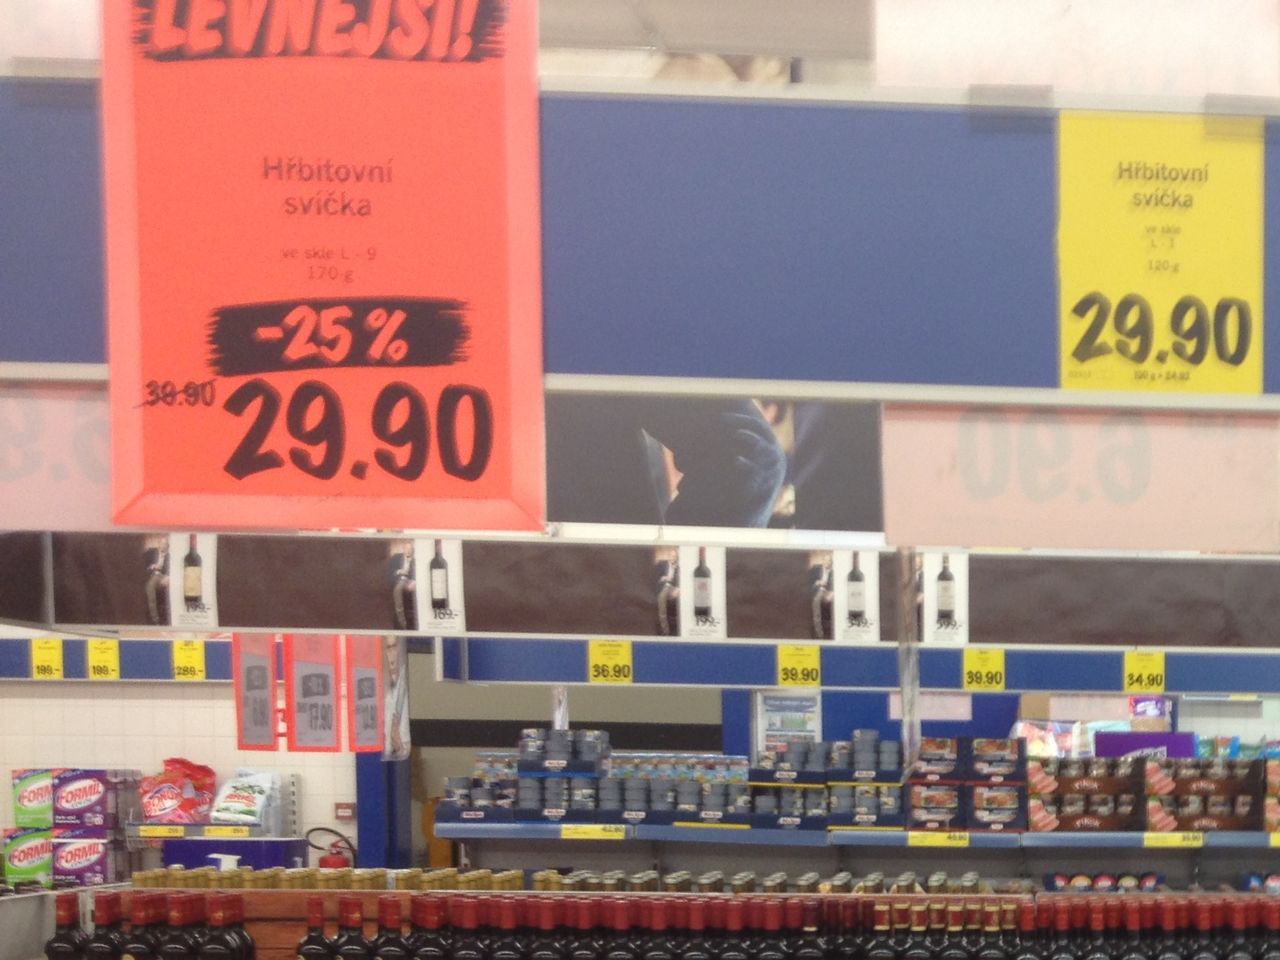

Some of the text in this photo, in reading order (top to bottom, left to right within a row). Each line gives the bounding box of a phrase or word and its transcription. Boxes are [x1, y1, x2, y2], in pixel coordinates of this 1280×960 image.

[262, 156, 393, 184] Hřbitovní
[1117, 161, 1210, 183] Hřbitovní
[284, 191, 373, 218] svíčka
[1133, 187, 1194, 209] svíčka
[307, 265, 338, 281] 170
[254, 305, 408, 364] -25 %
[1071, 290, 1252, 367] 29.90
[222, 378, 494, 481] 29.90
[592, 663, 631, 679] 36.90
[781, 667, 819, 682] 39.90
[966, 670, 1003, 686] 39.90
[1127, 672, 1164, 688] 34.90
[20, 783, 53, 803] FORM
[58, 780, 102, 804] FORMIL
[58, 842, 101, 863] FORMIL
